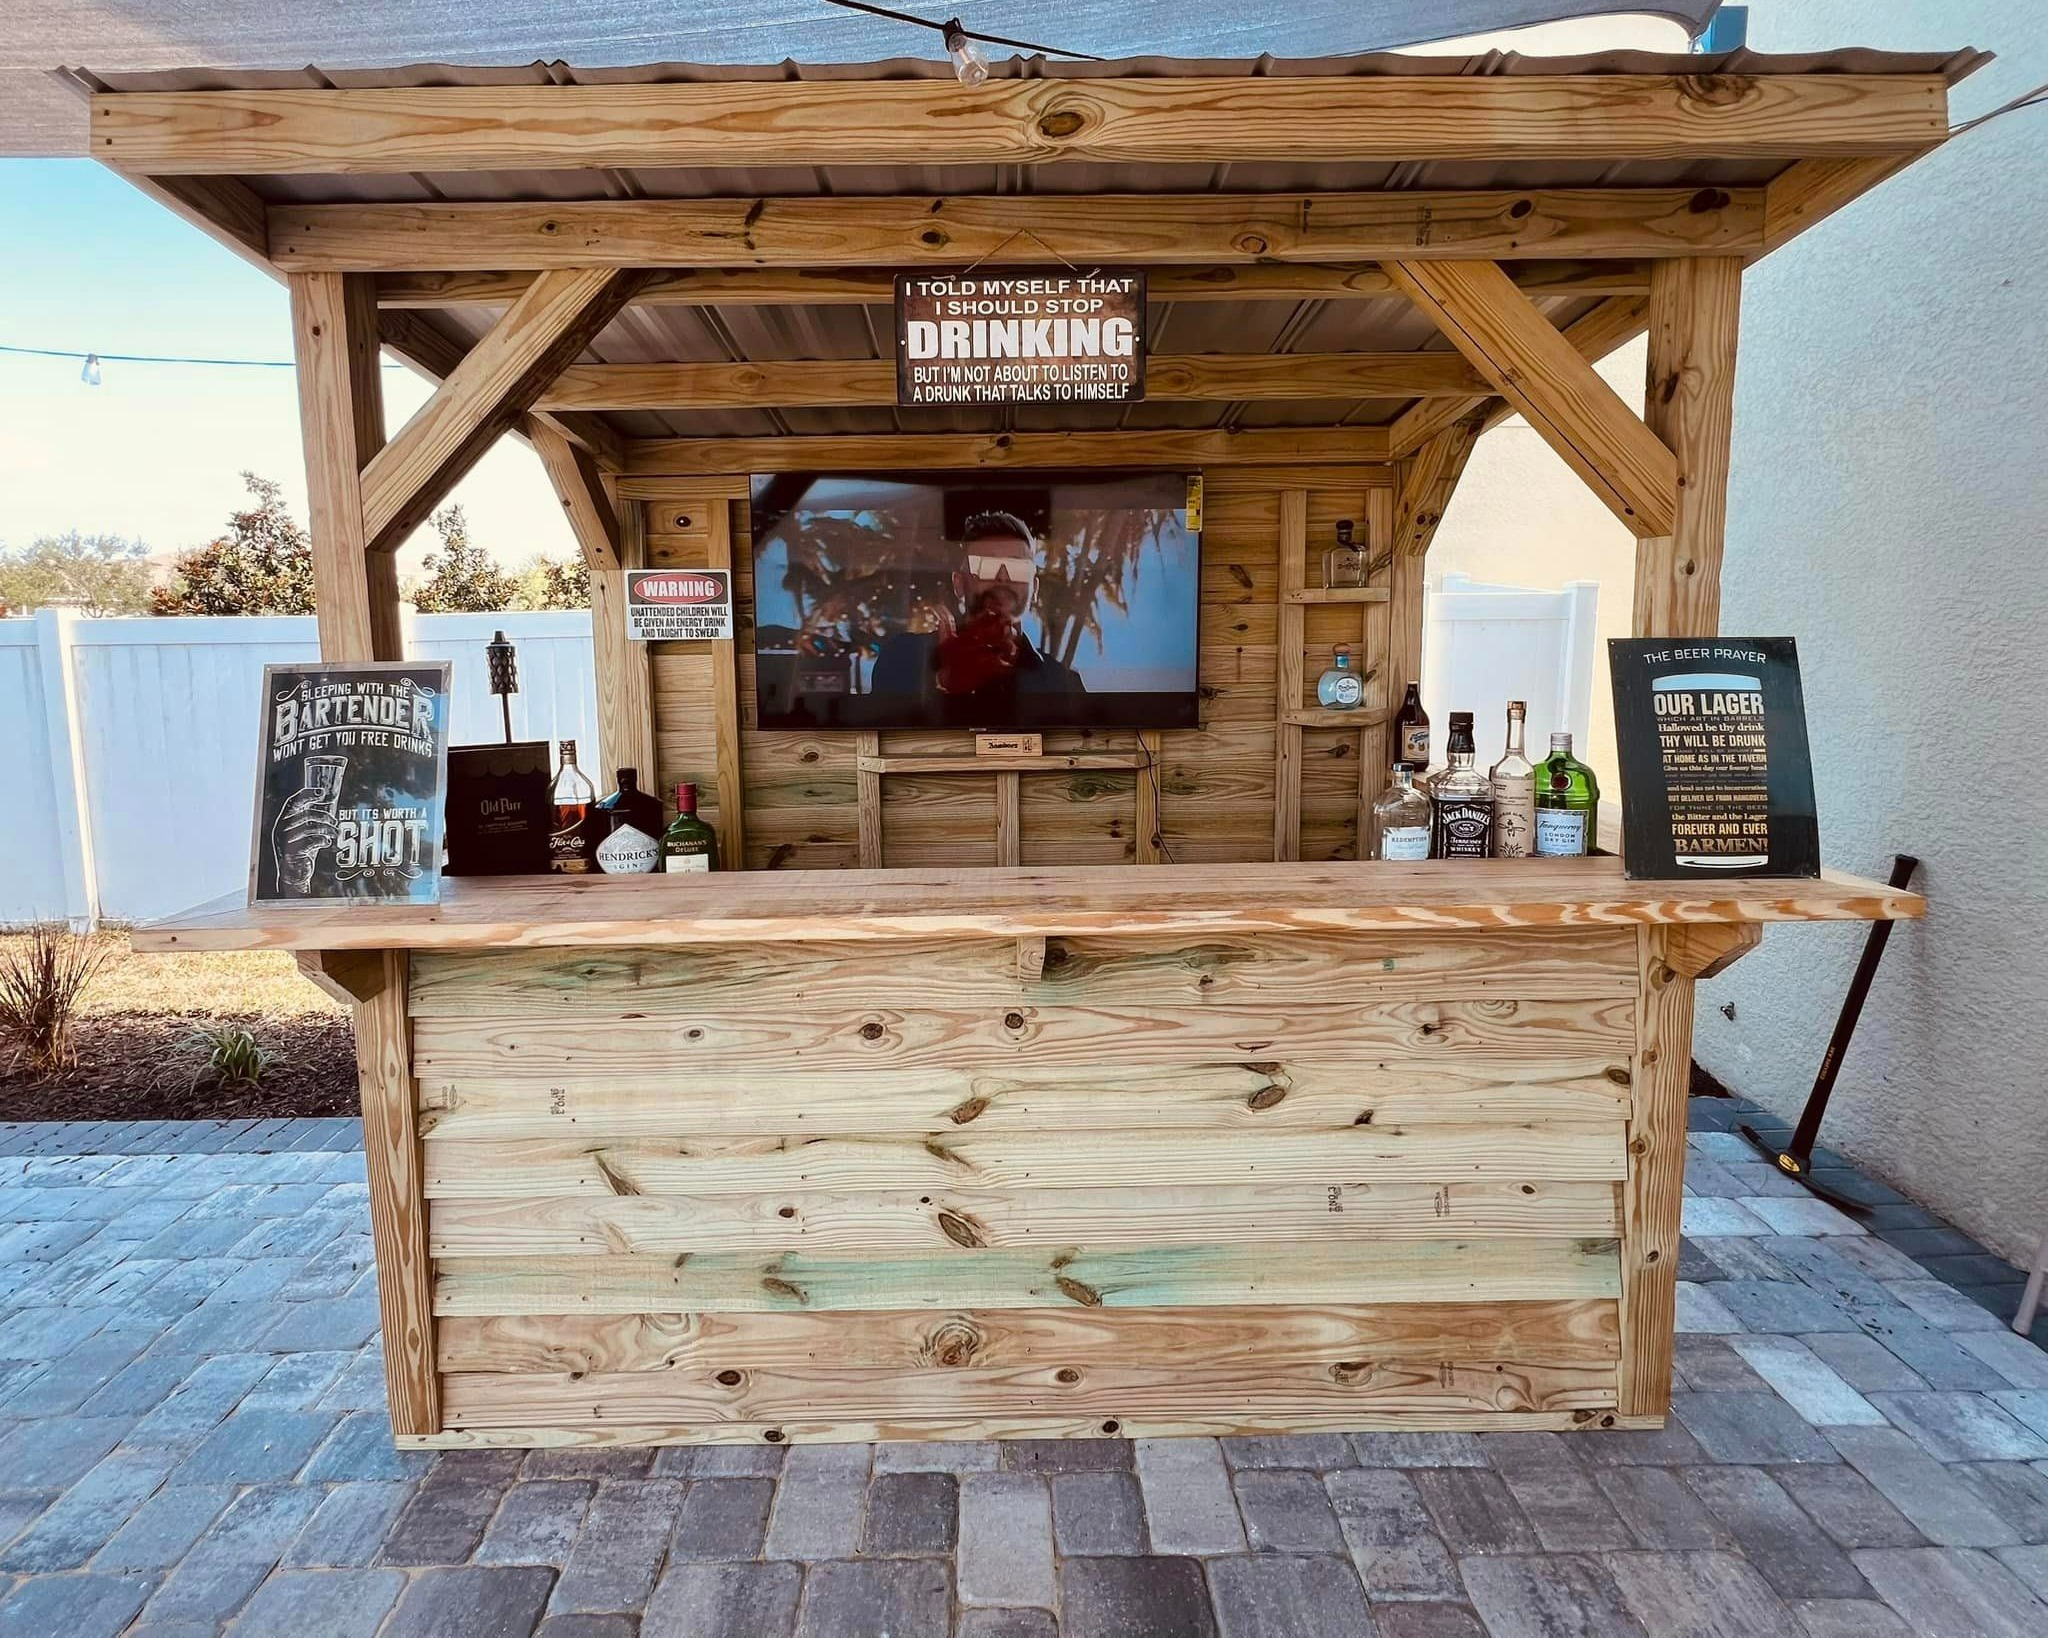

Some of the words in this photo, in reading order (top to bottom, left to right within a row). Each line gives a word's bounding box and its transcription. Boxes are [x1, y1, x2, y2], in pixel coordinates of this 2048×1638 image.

[905, 282, 911, 296] I
[917, 281, 976, 296] TOLD
[983, 280, 1070, 295] MYSELF
[1077, 278, 1133, 294] THAT
[935, 300, 941, 315] I
[947, 299, 1038, 315] SHOULD
[1045, 298, 1104, 314] STOP
[907, 316, 1134, 359] DRINKING
[914, 366, 940, 383] BUT
[943, 366, 961, 383] I'M
[964, 366, 991, 383] NOT
[993, 364, 1039, 382] ABOUT
[1041, 364, 1060, 382] TO
[1062, 363, 1107, 381] LISTEN
[1110, 363, 1128, 381] TO
[913, 385, 923, 402] A
[925, 384, 971, 402] DRUNK
[974, 384, 1007, 402] THAT
[1009, 383, 1051, 401] TALKS
[1053, 383, 1072, 400] TO
[1074, 382, 1130, 400] HIMSELF
[642, 580, 715, 597] WARNING
[630, 607, 675, 617] UNATTENDED
[676, 607, 710, 617] CHILDREN
[710, 606, 728, 617] WILL
[634, 618, 643, 627] BE
[643, 618, 665, 627] GIVEN
[665, 618, 676, 627] AN
[676, 618, 703, 627] ENERGY
[703, 618, 726, 627] DRINK
[641, 628, 656, 638] AND
[657, 628, 683, 638] TAUGHT
[685, 628, 694, 638] TO
[695, 628, 720, 638] SWEAR
[1643, 651, 1671, 664] THE
[1675, 648, 1710, 660] BEER
[1714, 648, 1767, 664] PRAYER
[301, 683, 352, 701] SLEEPING
[357, 682, 384, 695] WITH
[389, 683, 410, 699] THE
[1653, 693, 1695, 715] OUR
[1700, 693, 1765, 715] LAGER
[274, 694, 435, 747] BARTENDER
[1658, 723, 1704, 732] Hallowed
[1705, 723, 1718, 732] be
[1719, 723, 1736, 733] thy
[1737, 722, 1765, 731] drink
[309, 733, 332, 750] GET
[336, 731, 356, 746] YOU
[361, 731, 389, 747] FREE
[394, 734, 433, 758] DRINKS
[1659, 735, 1681, 748] THY
[1683, 735, 1710, 747] WILL
[1712, 735, 1726, 747] BE
[1728, 735, 1767, 747] DRUNK
[1662, 755, 1673, 764] AT
[1674, 755, 1697, 763] HOME
[1698, 755, 1709, 763] AS
[1711, 755, 1720, 763] IN
[1721, 754, 1736, 763] THE
[1738, 754, 1767, 763] TAVERN
[338, 809, 357, 821] BUT
[362, 809, 375, 821] ITS
[383, 808, 417, 820] WORTH
[421, 807, 427, 818] A
[480, 799, 499, 815] Old
[1442, 809, 1461, 824] JACK
[1744, 813, 1768, 821] Lager
[1672, 823, 1716, 836] FOREVER
[1718, 823, 1740, 835] AND
[1742, 823, 1768, 835] EVER
[335, 819, 429, 869] SHOT
[1674, 837, 1769, 853] BARMEN!
[599, 848, 659, 862] HENDRICK'S
